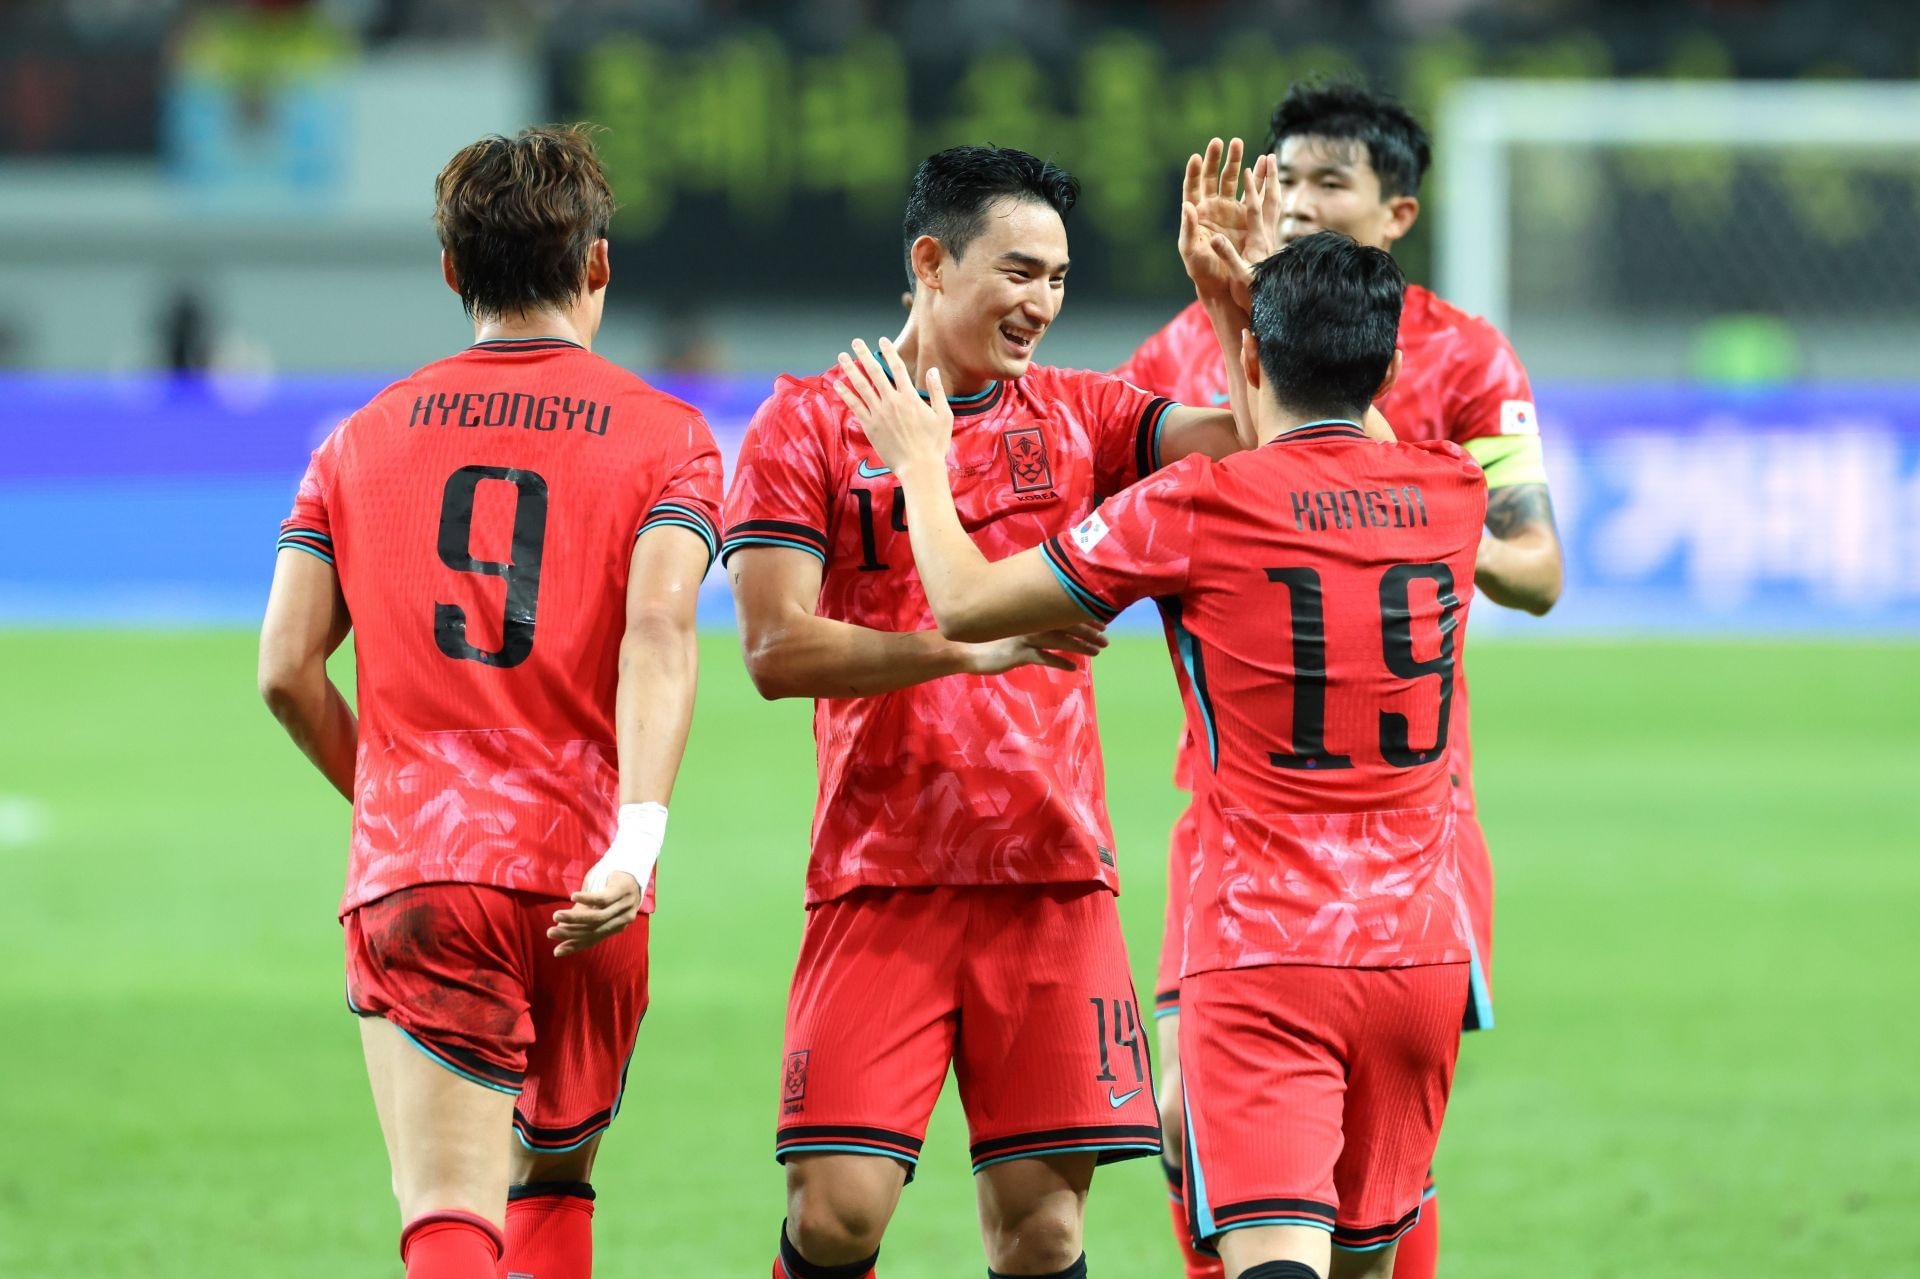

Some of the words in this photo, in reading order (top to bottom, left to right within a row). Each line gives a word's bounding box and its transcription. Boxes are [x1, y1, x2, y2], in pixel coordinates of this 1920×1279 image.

[409, 392, 612, 436] HYEONGYU
[1016, 491, 1059, 502] KOREA
[1290, 485, 1428, 532] KANGIN
[434, 465, 549, 669] 9
[1262, 562, 1460, 770] 19
[1089, 997, 1144, 1083] 14
